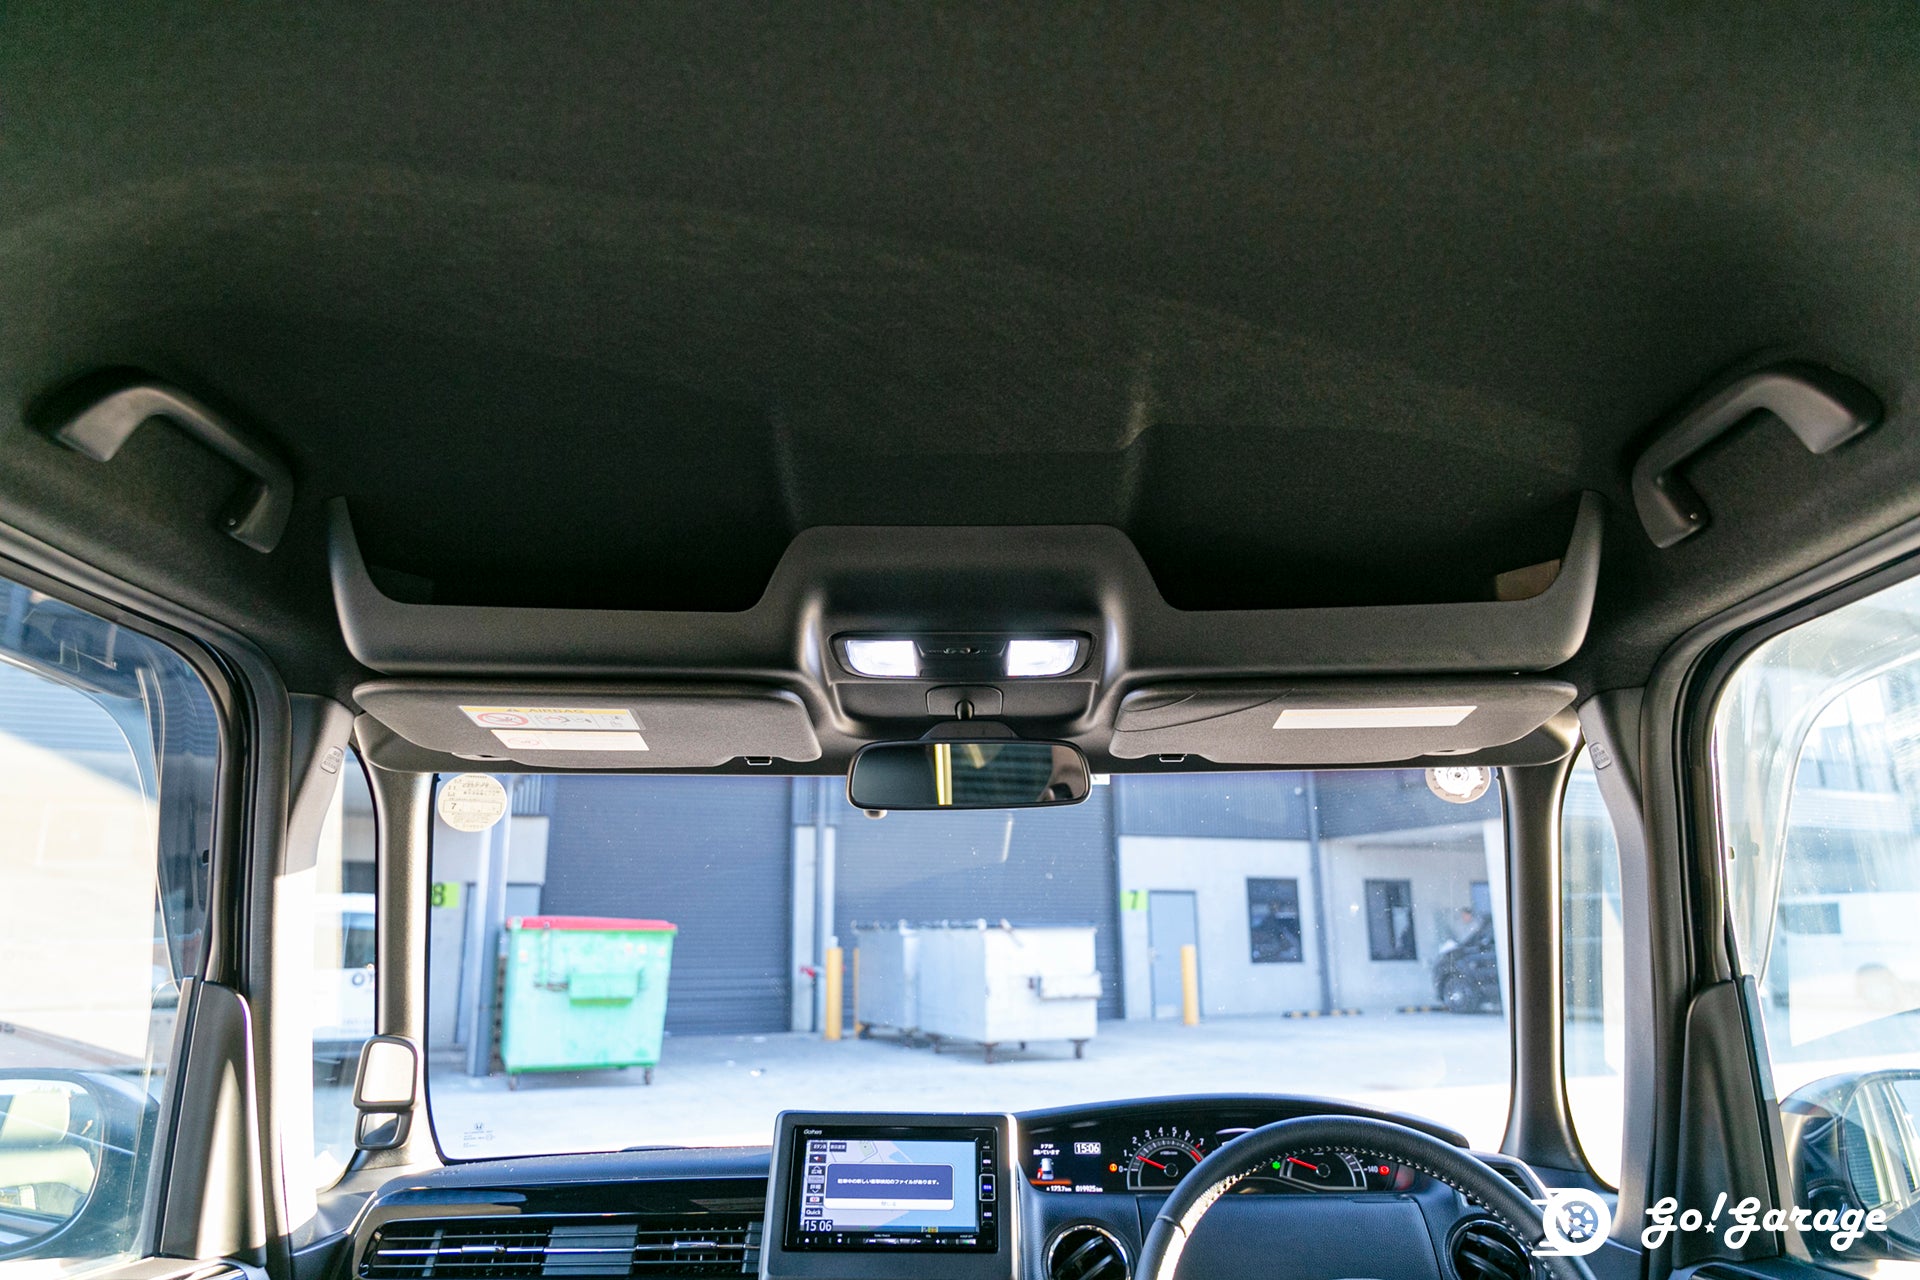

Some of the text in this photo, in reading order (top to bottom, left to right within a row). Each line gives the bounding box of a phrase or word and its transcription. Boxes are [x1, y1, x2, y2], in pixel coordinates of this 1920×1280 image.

[431, 882, 446, 907] 8
[1129, 889, 1139, 910] 7
[1144, 1129, 1150, 1137] 3
[1158, 1126, 1163, 1134] 4
[1171, 1126, 1178, 1134] 5
[1185, 1129, 1191, 1137] 6
[1132, 1136, 1138, 1144] 2
[1199, 1137, 1205, 1146] 7
[1075, 1142, 1100, 1154] 15:06
